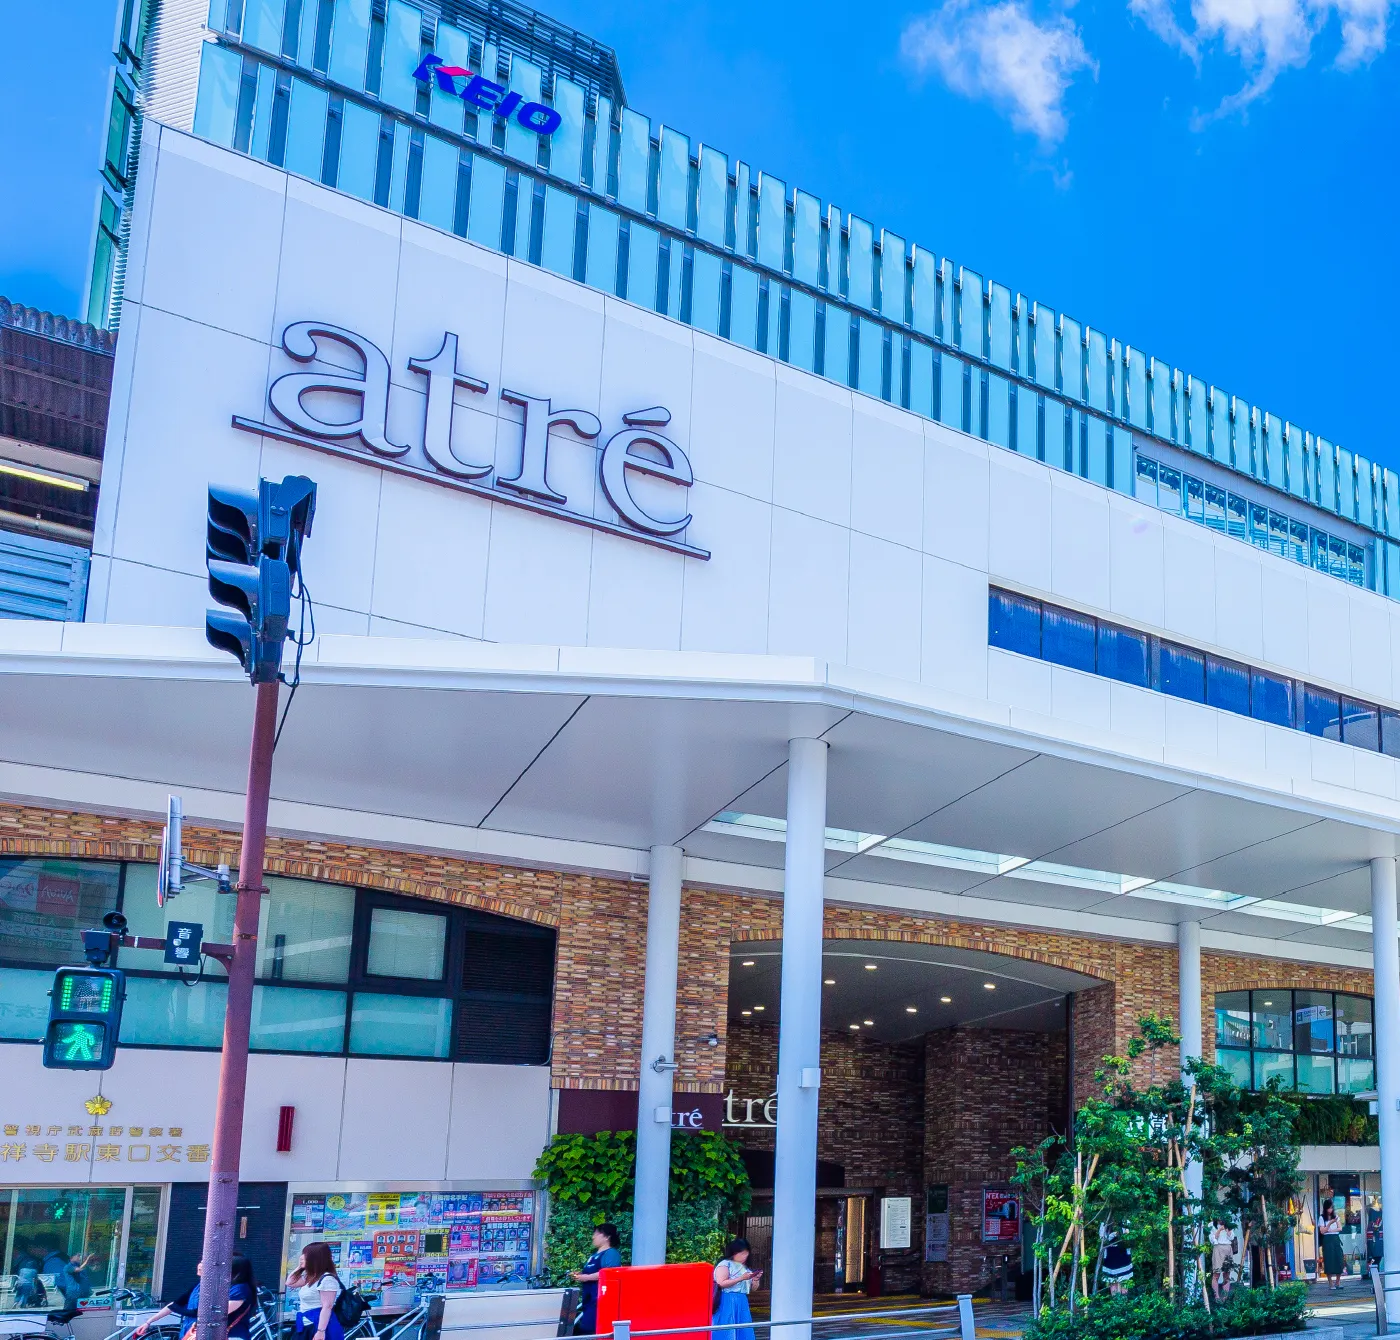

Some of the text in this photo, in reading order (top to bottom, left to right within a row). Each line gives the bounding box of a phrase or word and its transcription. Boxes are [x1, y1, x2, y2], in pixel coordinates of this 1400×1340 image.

[412, 53, 562, 135] KEIO
[268, 320, 694, 536] atré
[175, 928, 192, 958] 音響
[722, 1089, 777, 1123] tré
[4, 1124, 183, 1137] 警視庁武蔵野警察署
